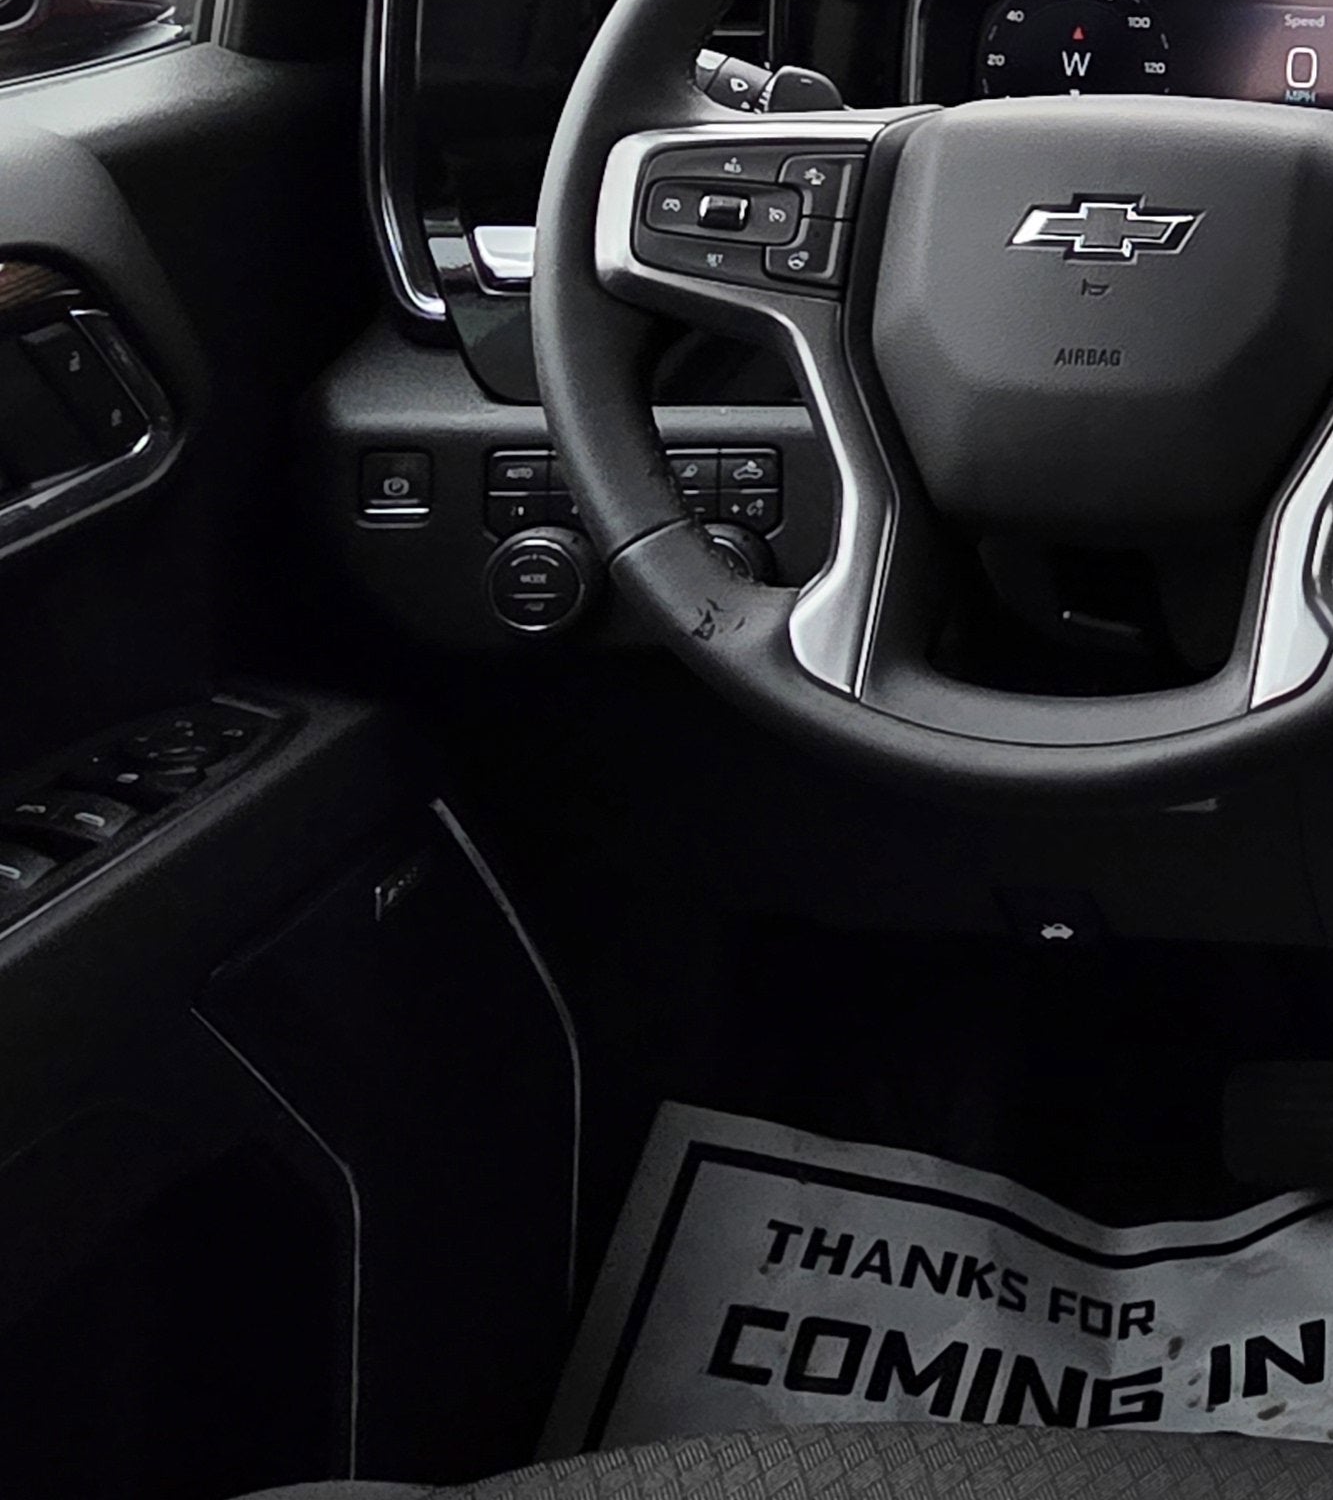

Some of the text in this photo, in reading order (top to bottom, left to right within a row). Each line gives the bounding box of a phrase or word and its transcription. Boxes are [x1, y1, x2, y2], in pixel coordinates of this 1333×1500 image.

[1006, 10, 1024, 22] 40
[1128, 17, 1150, 28] 100
[1284, 13, 1325, 29] Speed
[987, 54, 1005, 66] 20
[1062, 51, 1091, 76] W
[1144, 62, 1166, 74] 120
[1286, 47, 1317, 89] 0
[1286, 90, 1316, 103] MPH
[1054, 348, 1121, 366] AIRBAG
[506, 467, 533, 478] AUTO
[766, 1218, 1155, 1340] THANKS FOR
[707, 1304, 1326, 1428] COMING IN
